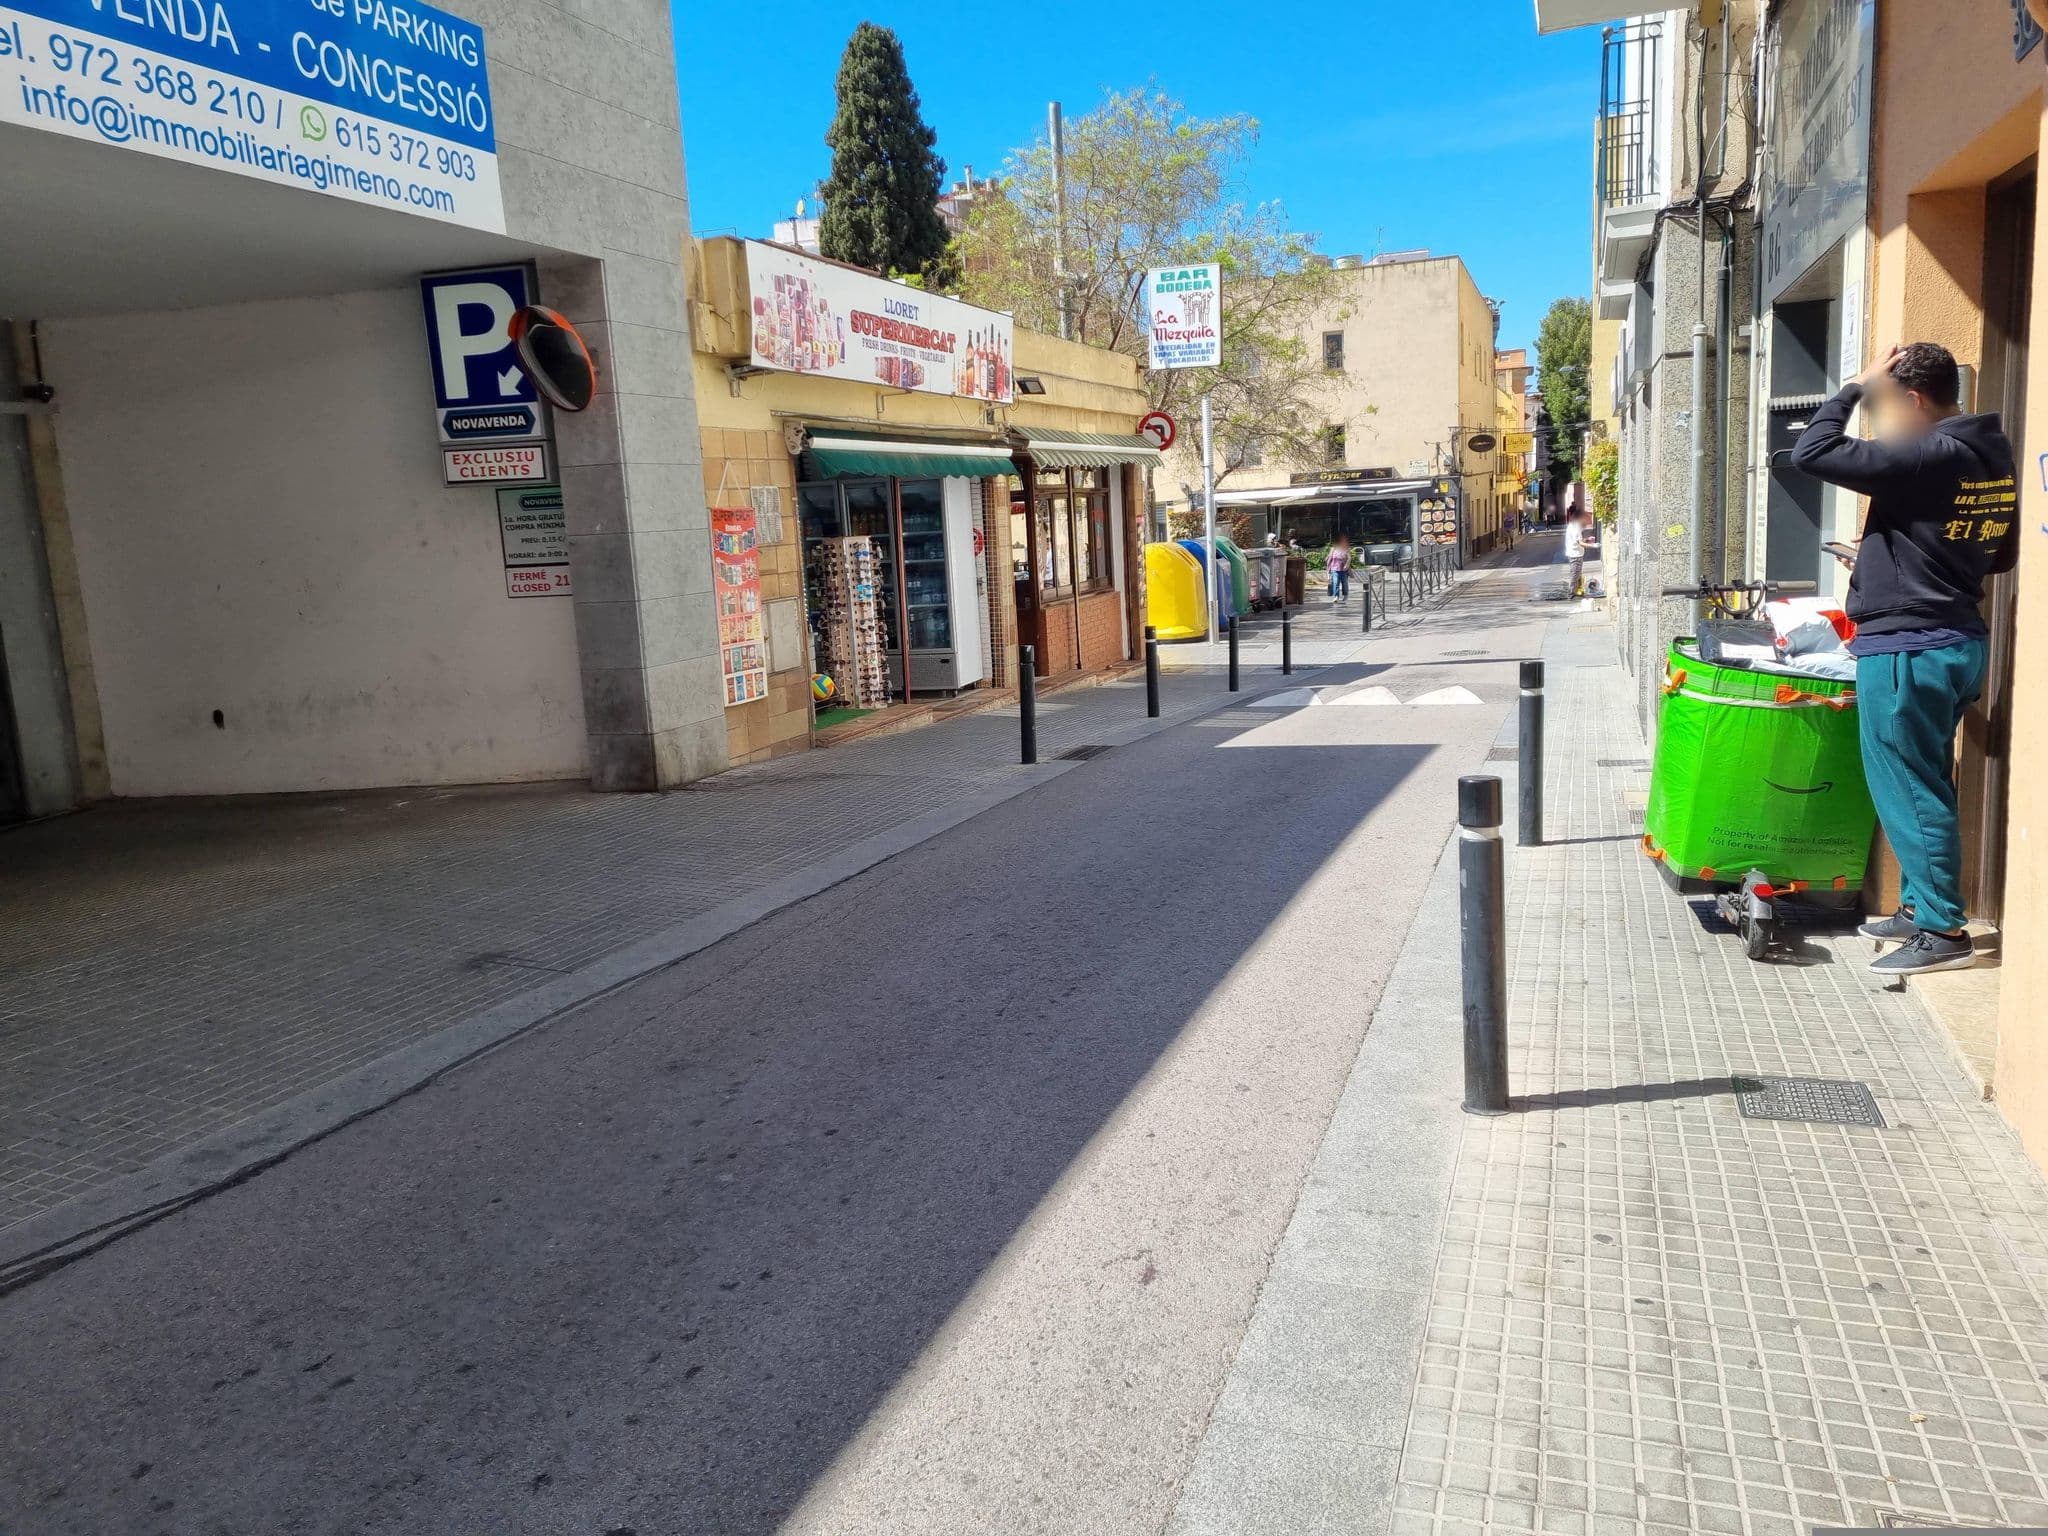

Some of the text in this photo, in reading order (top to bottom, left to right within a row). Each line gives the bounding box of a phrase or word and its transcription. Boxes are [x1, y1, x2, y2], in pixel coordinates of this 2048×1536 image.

[355, 0, 479, 67] PARKING
[292, 31, 487, 132] CONCESSIÓ
[48, 33, 122, 86] 972
[132, 57, 198, 106] 368
[207, 79, 265, 124] 210
[335, 117, 381, 155] 615
[387, 132, 431, 170] 372
[437, 146, 476, 182] 903
[20, 74, 456, 214] info@immobiliariagimeno.com
[1160, 268, 1209, 282] BAR
[1156, 279, 1212, 293] BODEGA
[884, 298, 919, 321] LLORET
[1155, 310, 1179, 325] La
[850, 309, 956, 354] SUPERMERCAT
[1152, 324, 1216, 343] Mezquita
[432, 282, 518, 400] P
[452, 414, 527, 431] NOVAVENDA
[452, 450, 535, 465] EXCLUSIU
[460, 464, 530, 478] CLIENTS
[512, 569, 547, 581] FERMÉ
[554, 574, 571, 586] 21
[511, 583, 551, 593] CLOSED
[1713, 826, 1755, 840] Property
[1759, 833, 1769, 841] of
[1707, 836, 1724, 846] Not
[1727, 839, 1741, 848] for
